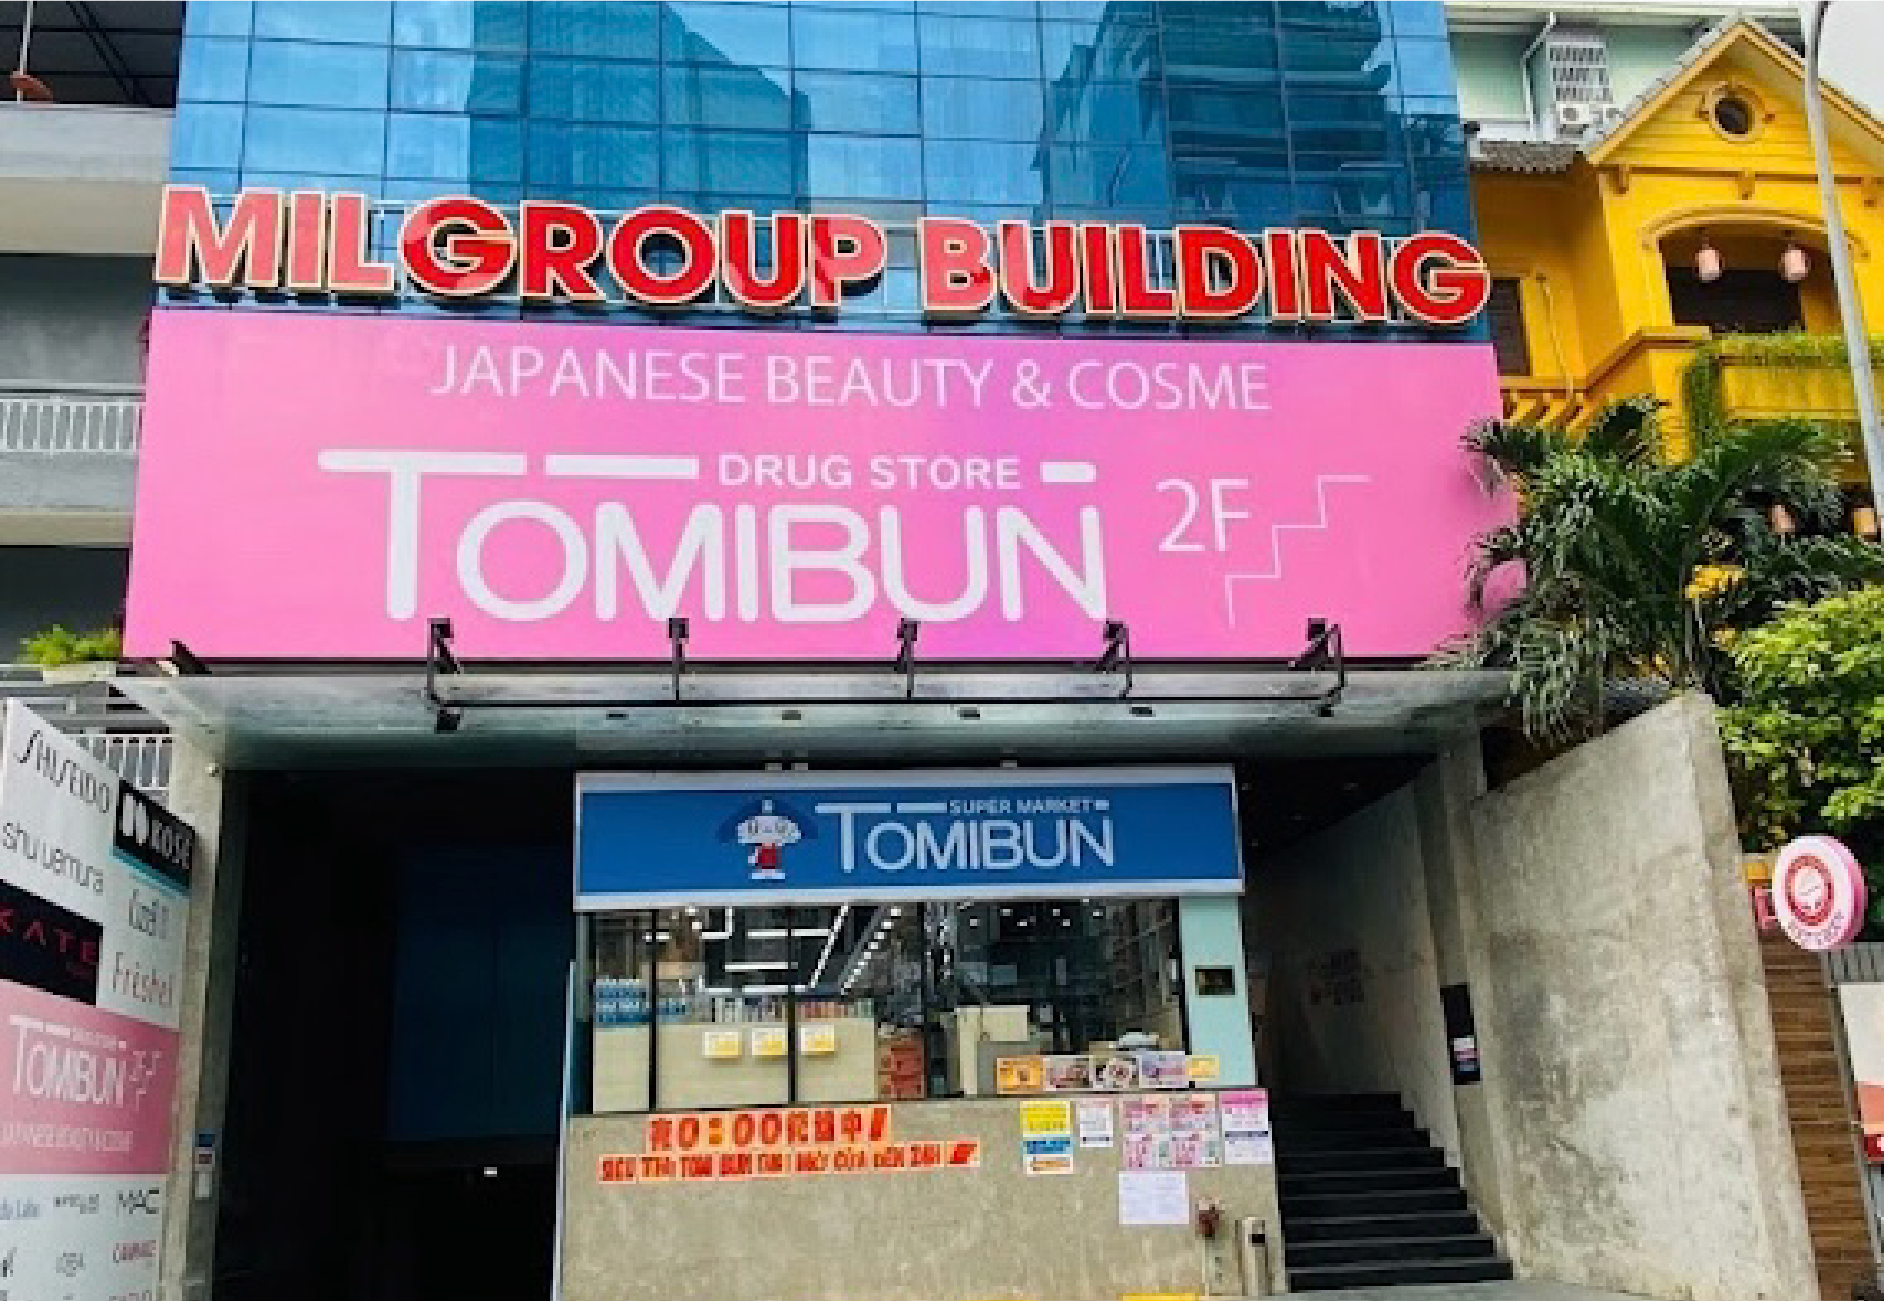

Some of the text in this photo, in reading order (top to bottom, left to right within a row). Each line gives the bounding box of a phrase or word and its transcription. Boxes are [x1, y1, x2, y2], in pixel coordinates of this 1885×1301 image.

[153, 185, 1491, 327] MILGROUP BUILDING
[430, 345, 1271, 412] JAPANESE BEAUTY & COSME
[718, 454, 1020, 491] DRUG STORE
[317, 446, 1108, 623] TOMIBUN
[1155, 478, 1253, 554] 2F
[14, 729, 111, 814] SHISEIDO
[948, 797, 1095, 815] SUPER MARKET
[1, 821, 105, 893] shu uemura
[815, 800, 1116, 874] TOMIBUN
